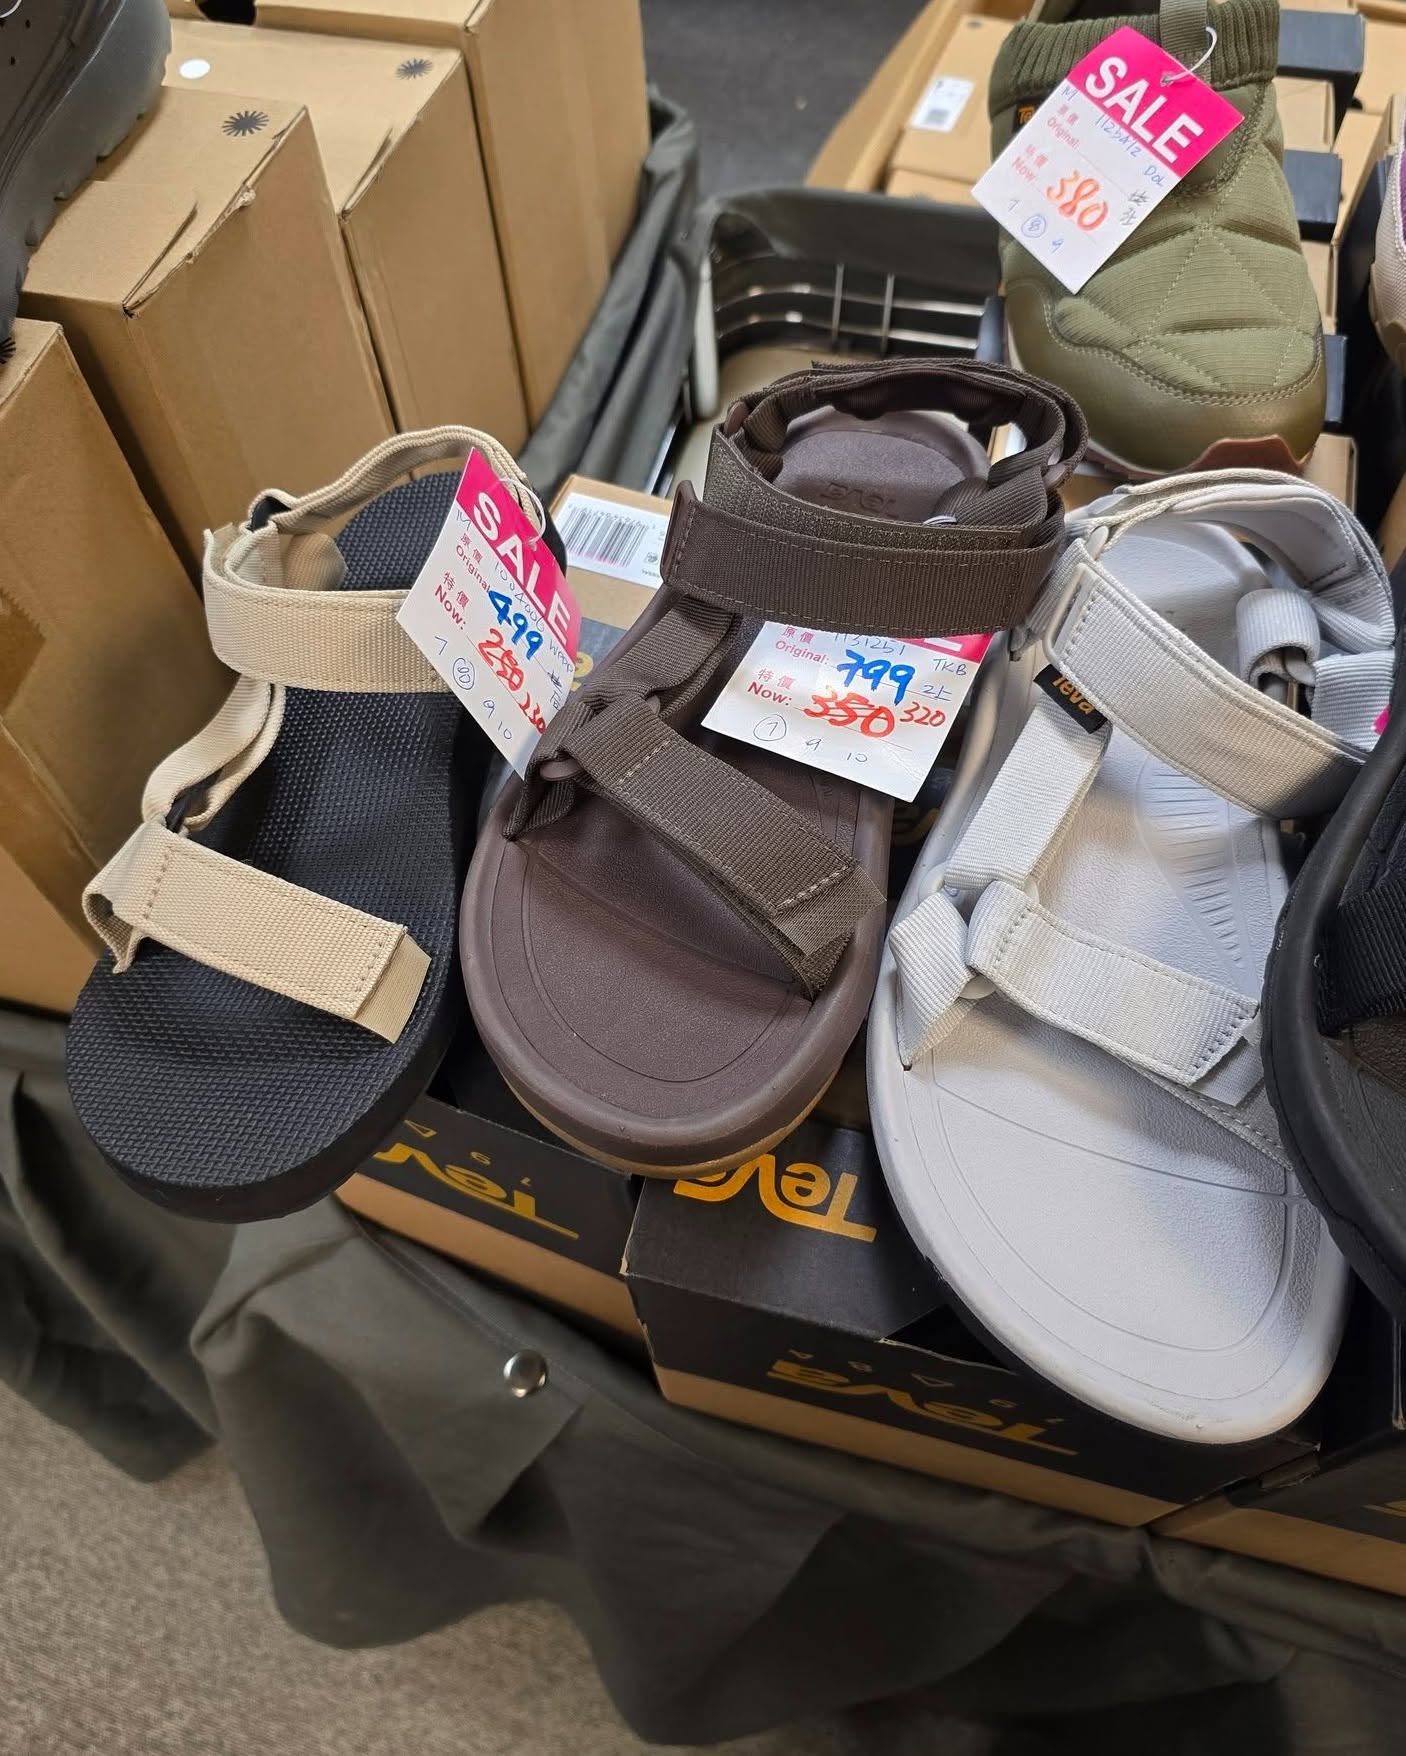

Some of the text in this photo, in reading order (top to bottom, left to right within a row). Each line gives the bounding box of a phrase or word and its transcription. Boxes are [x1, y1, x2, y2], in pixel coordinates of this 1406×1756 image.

[1018, 106, 1034, 125] Te
[1085, 56, 1204, 164] SALE
[1046, 170, 1109, 232] 380
[460, 532, 484, 566] 原價
[473, 492, 571, 645] SALE
[435, 586, 467, 631] Now:
[443, 571, 471, 611] 特價
[487, 588, 543, 660] 499
[782, 625, 816, 646] 原價
[434, 635, 449, 656] 7
[482, 698, 496, 720] 9
[497, 720, 513, 741] 10
[758, 668, 796, 690] 特價
[775, 639, 831, 665] Original:
[836, 649, 916, 706] 799
[933, 658, 968, 676] TKB
[747, 681, 793, 706] Now:
[900, 701, 946, 727] 320
[806, 738, 822, 751] 9
[846, 751, 868, 764] 10
[374, 1142, 579, 1240] Tev
[673, 1153, 877, 1243] Tev
[767, 1358, 1080, 1456] Teva
